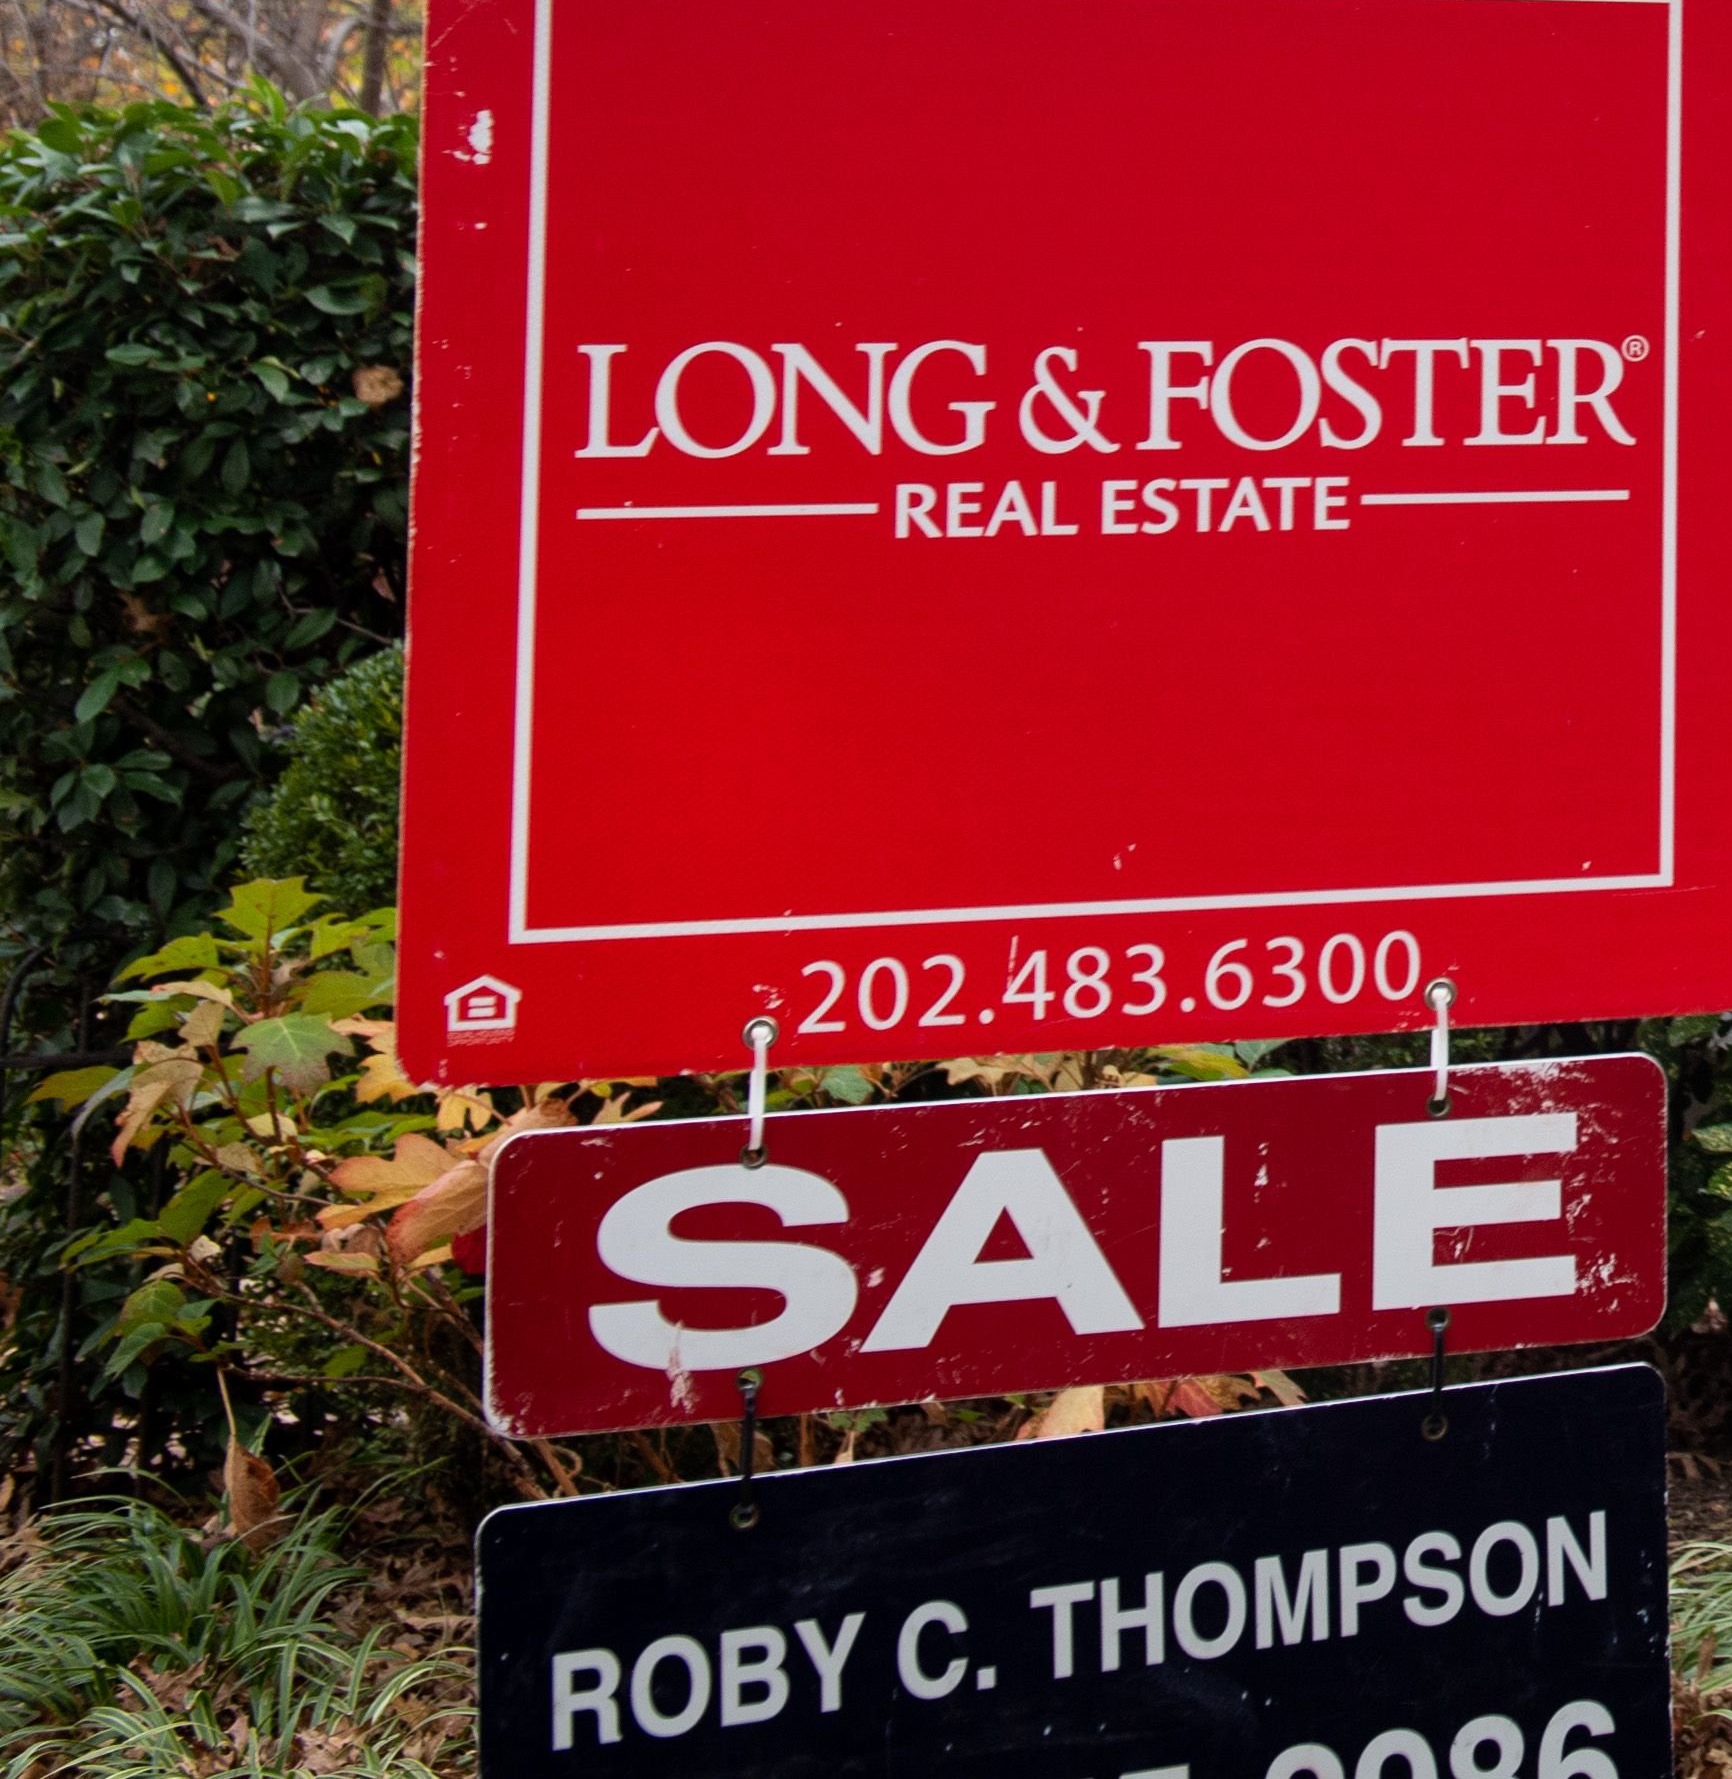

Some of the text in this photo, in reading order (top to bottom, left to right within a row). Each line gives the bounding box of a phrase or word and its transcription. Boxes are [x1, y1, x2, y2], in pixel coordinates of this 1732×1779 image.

[574, 339, 996, 459] LONG
[1018, 346, 1121, 455] &
[895, 476, 1350, 539] REAL ESTATE
[797, 930, 1421, 1034] 202.483.6300
[588, 1112, 1577, 1371] SALE
[552, 1510, 1607, 1751] ROBY C. THOMPSON
